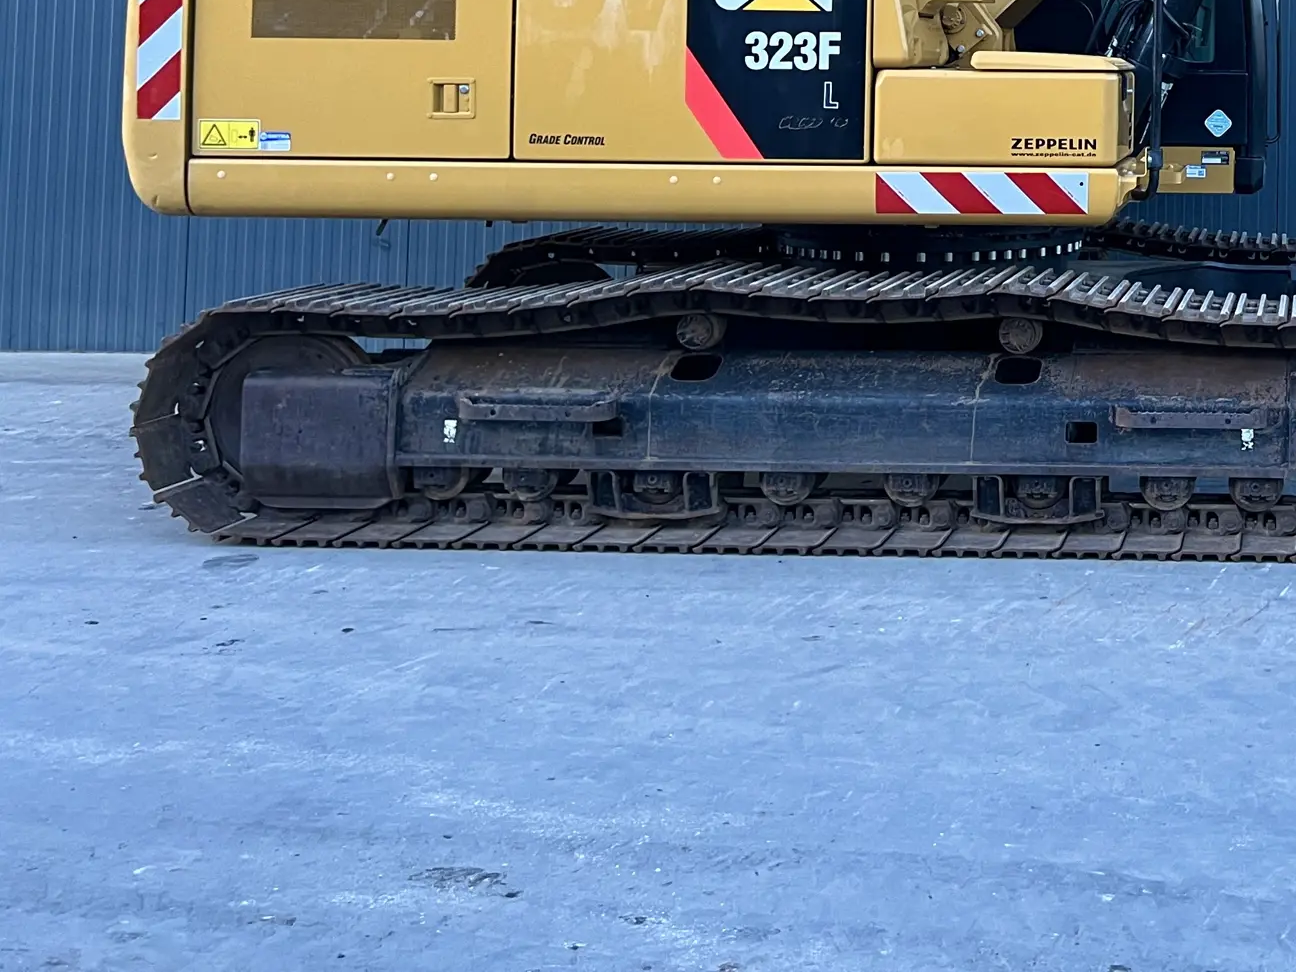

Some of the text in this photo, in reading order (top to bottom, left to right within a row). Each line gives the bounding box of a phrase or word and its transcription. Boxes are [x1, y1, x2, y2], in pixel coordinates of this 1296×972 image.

[744, 31, 842, 71] 323F
[823, 81, 839, 110] L
[529, 133, 605, 146] GRADE CONTROL
[1011, 138, 1097, 150] ZEPPELIN
